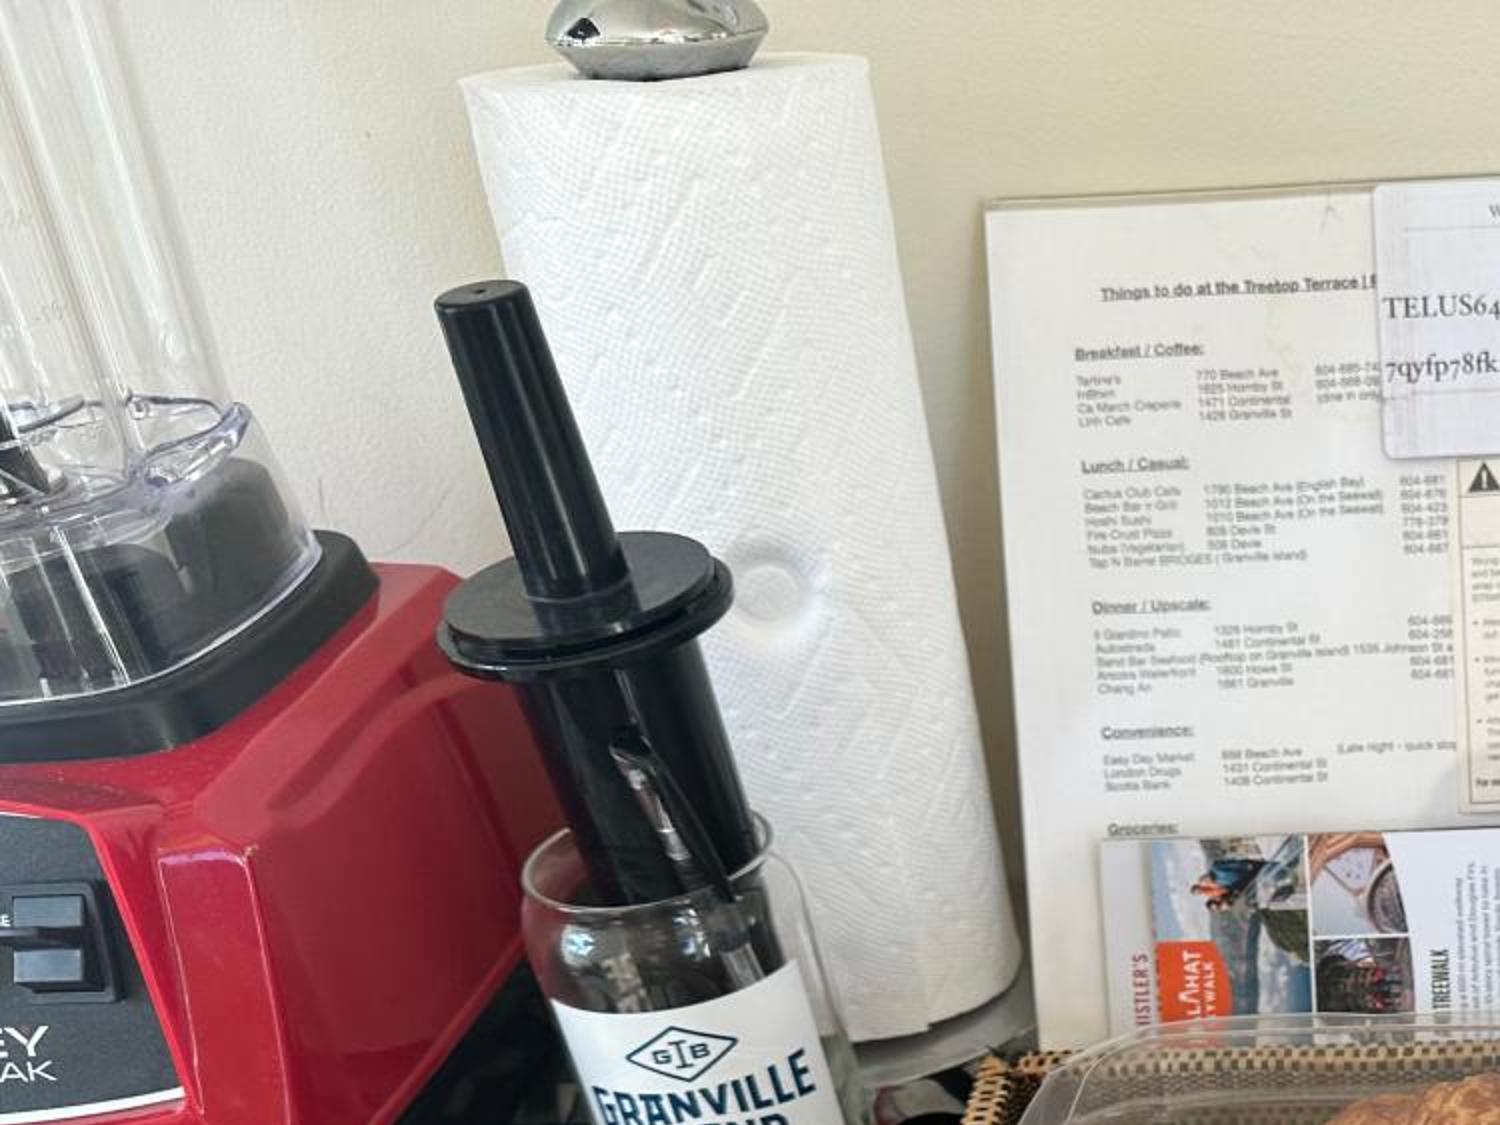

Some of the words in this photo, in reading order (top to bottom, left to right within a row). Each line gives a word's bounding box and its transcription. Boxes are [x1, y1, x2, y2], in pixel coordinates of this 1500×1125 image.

[1101, 287, 1149, 301] Things
[1154, 286, 1169, 298] to
[1173, 285, 1192, 297] do
[1198, 284, 1212, 296] at
[1216, 283, 1238, 296] the
[1243, 281, 1298, 296] Treetop
[1303, 278, 1359, 293] Terrace
[1075, 346, 1140, 361] Breakfast
[1153, 342, 1205, 357] Coffee:
[1081, 459, 1124, 475] Lunch
[1092, 600, 1137, 615] Dinner
[1101, 725, 1194, 740] Convenience:
[1252, 760, 1314, 774] Continental
[1253, 772, 1315, 787] Continental
[1107, 822, 1179, 837] Groceries:
[1432, 948, 1451, 1011] TREEWALK
